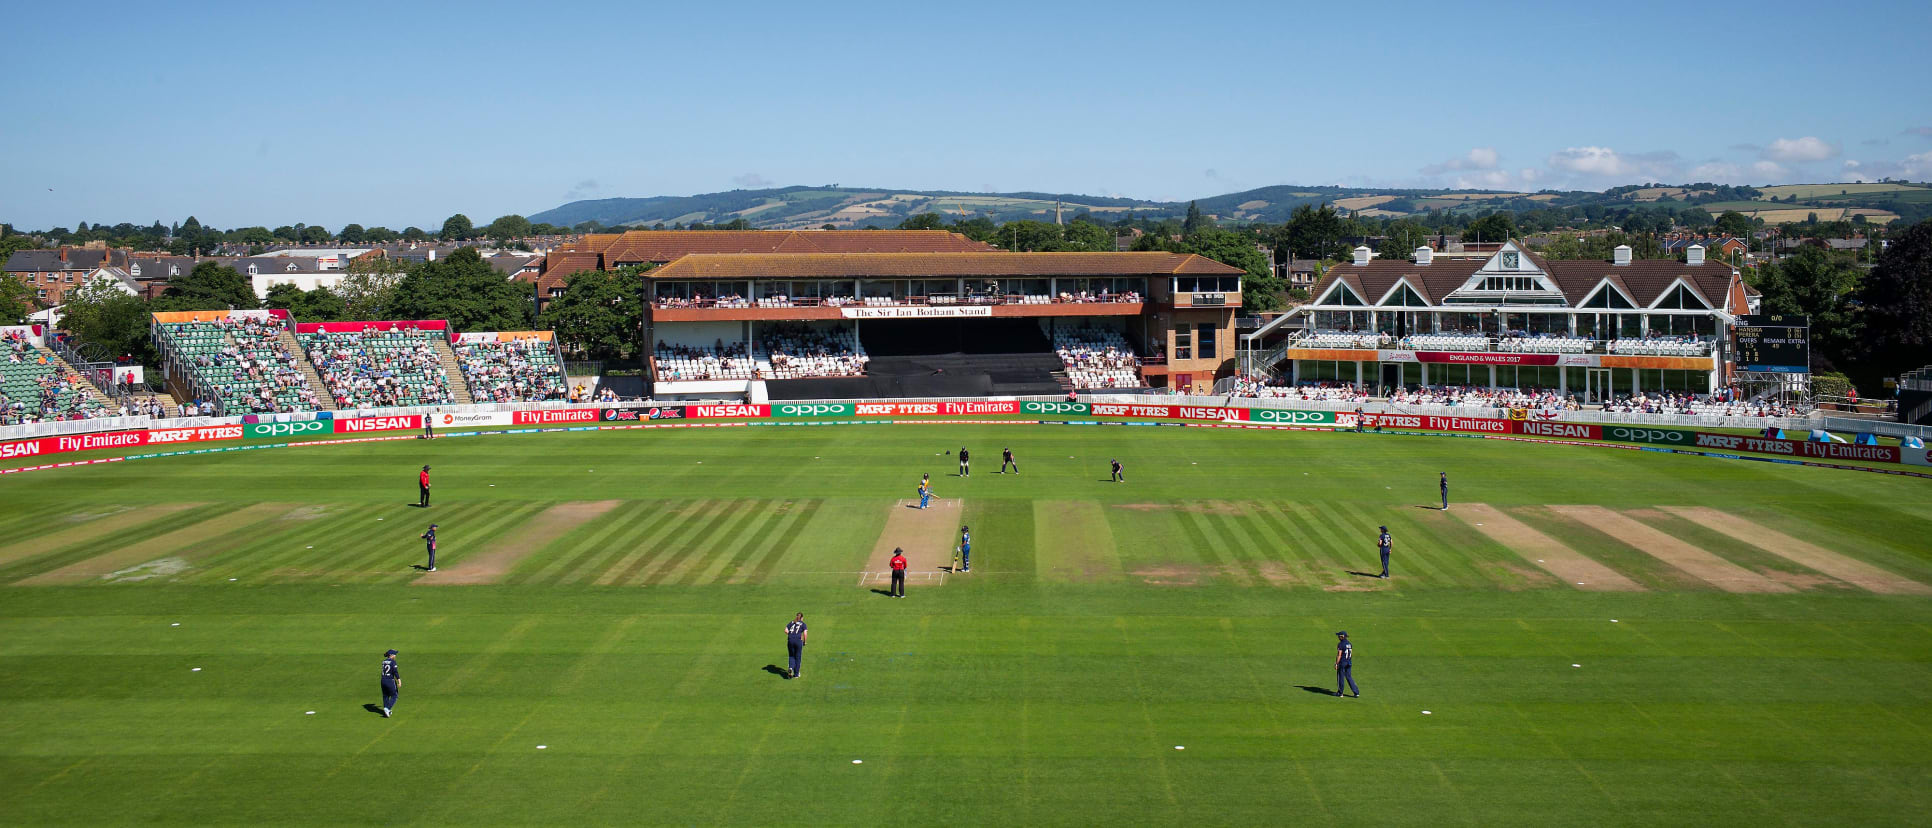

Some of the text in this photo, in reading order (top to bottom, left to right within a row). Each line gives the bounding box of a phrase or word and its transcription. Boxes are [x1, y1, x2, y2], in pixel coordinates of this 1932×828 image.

[697, 406, 760, 416] NISSAN
[782, 405, 845, 416] oppo
[856, 404, 938, 414] MRF TYRES
[946, 402, 1014, 414] Fly Emirates
[1026, 402, 1086, 413] oppo
[1092, 405, 1168, 416] MRF TYRES
[1180, 408, 1239, 419] NISSAN
[520, 410, 594, 424] Fly Emirates
[1260, 410, 1324, 422] oppo
[1379, 416, 1420, 427] TYRES
[1430, 416, 1504, 430] Fly Emirates
[255, 422, 323, 436] oppo
[346, 417, 410, 431] NISSAN
[1524, 422, 1590, 437] NISSAN
[148, 426, 242, 443] MRF TYRES
[1613, 428, 1683, 442] oppo
[59, 434, 140, 451] Fly Emirates
[1697, 434, 1794, 453] MRF TYRES
[1804, 442, 1826, 458] Fly
[1830, 444, 1892, 460] Emirates
